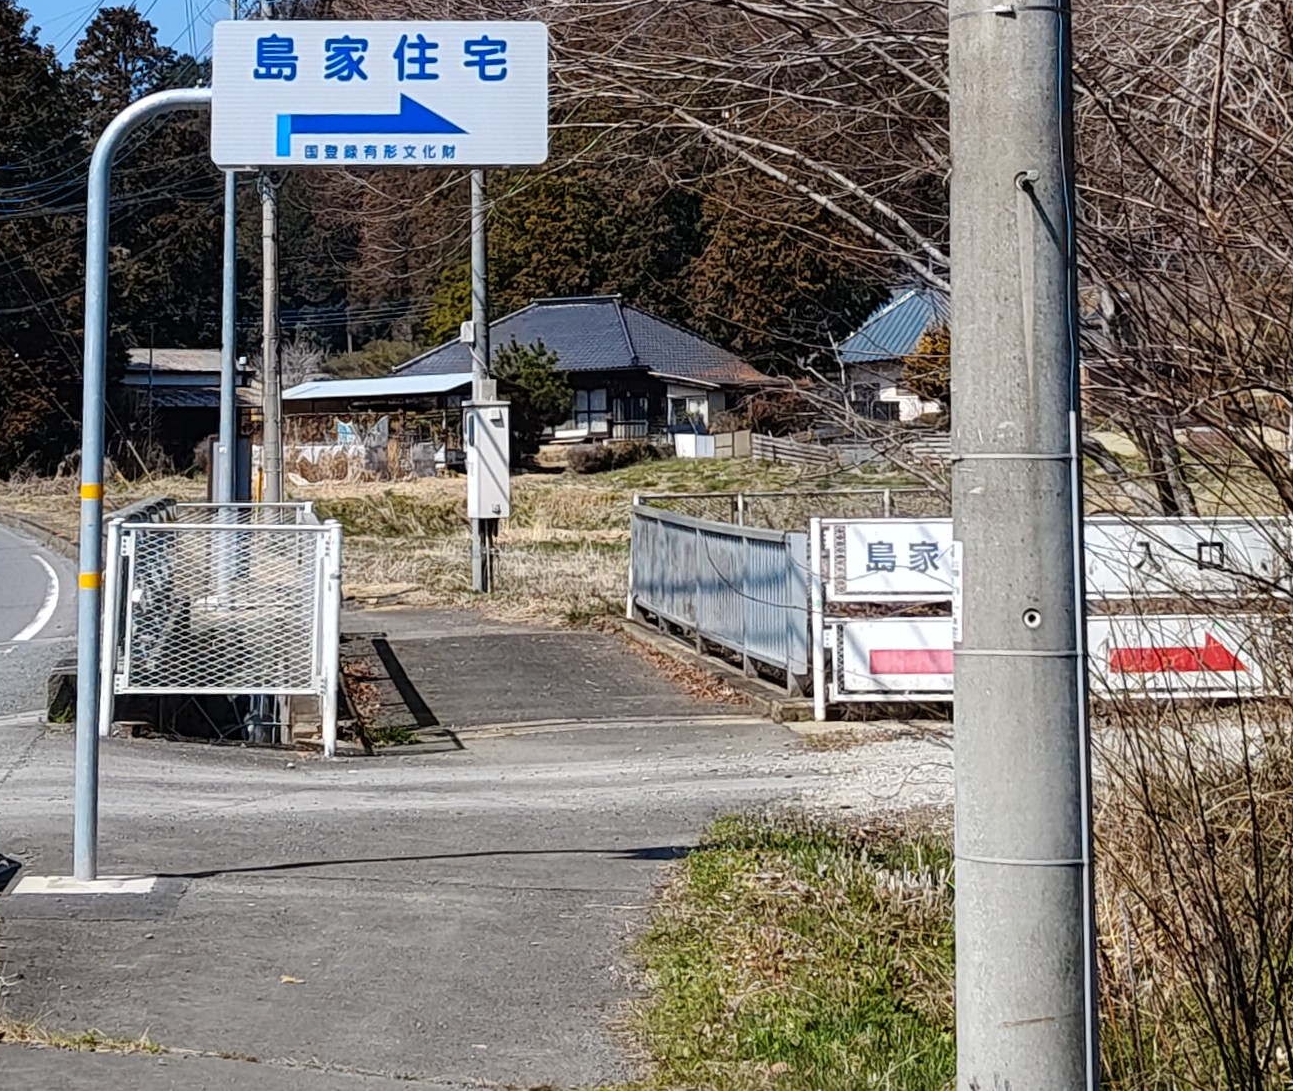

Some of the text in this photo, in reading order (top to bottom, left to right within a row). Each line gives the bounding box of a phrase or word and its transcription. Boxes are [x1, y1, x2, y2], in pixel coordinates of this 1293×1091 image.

[253, 33, 508, 82] 島家住宅
[304, 145, 456, 159] 国登録有形文化財
[1134, 541, 1224, 571] 入口
